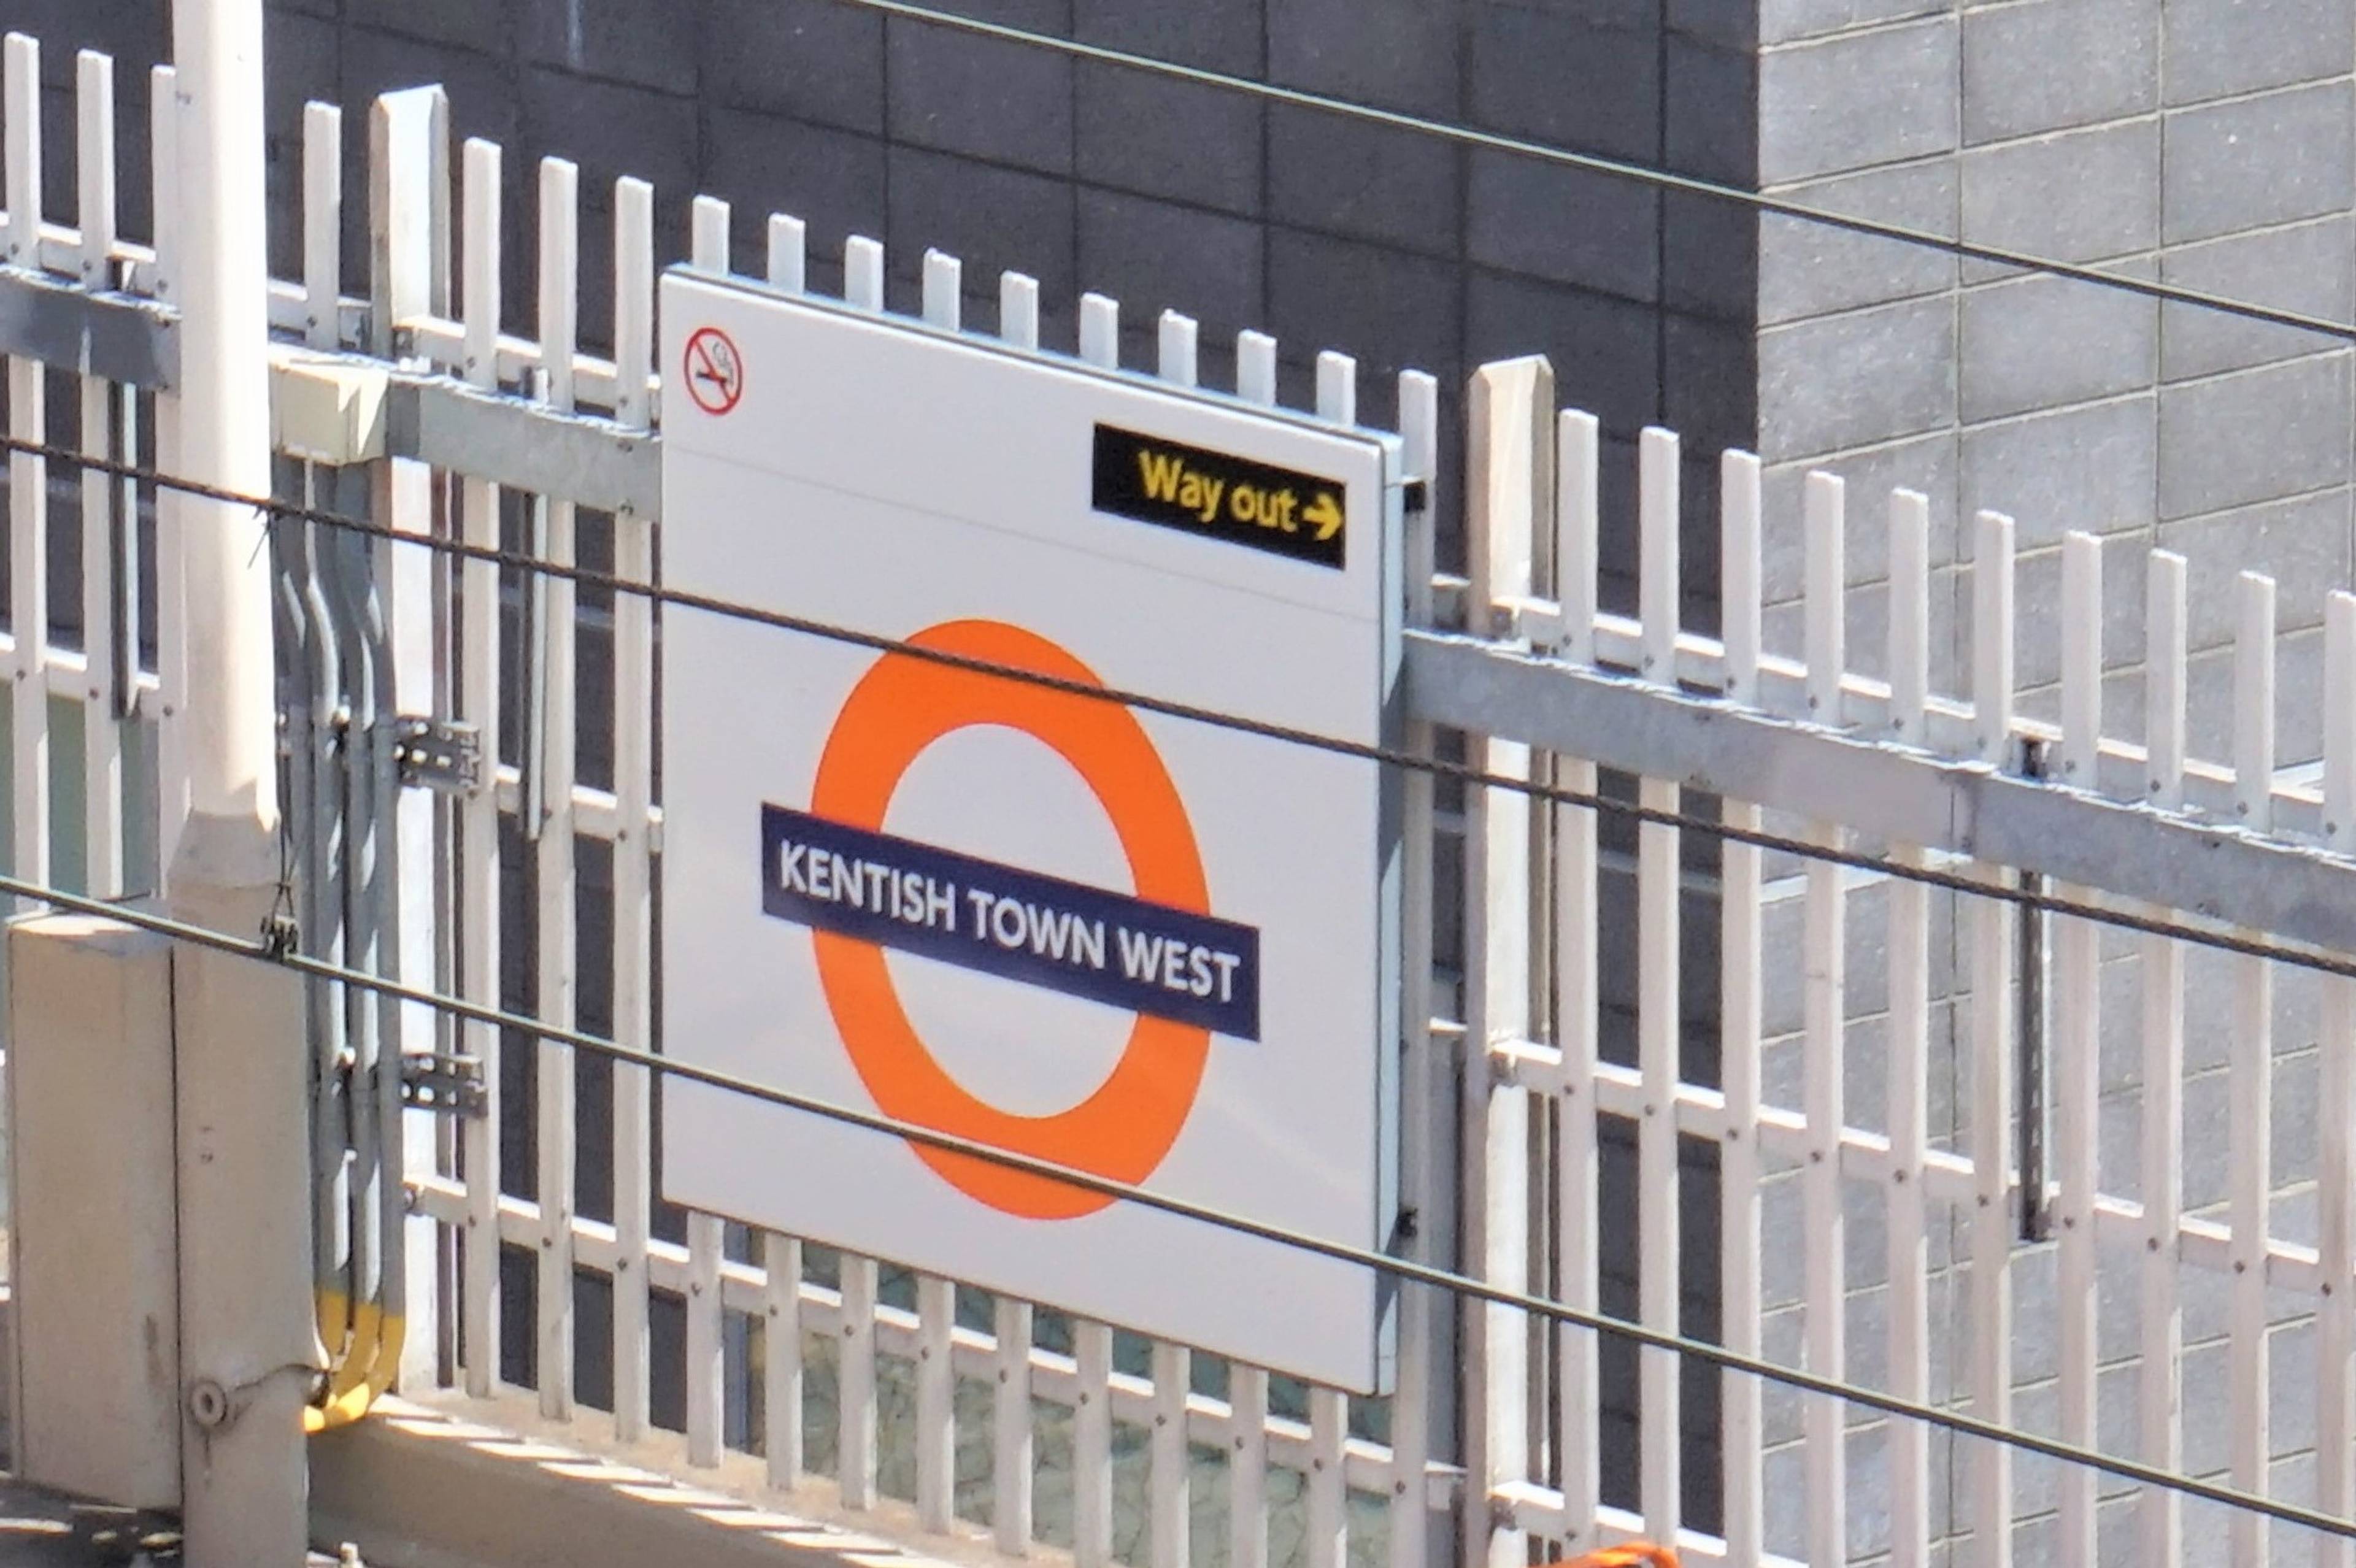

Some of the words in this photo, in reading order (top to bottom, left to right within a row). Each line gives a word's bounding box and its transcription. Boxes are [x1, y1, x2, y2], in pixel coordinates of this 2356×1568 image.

[1139, 450, 1223, 522] Way
[1230, 483, 1298, 532] out
[780, 839, 956, 932] KENTISH
[967, 888, 1104, 969] TOWN
[1118, 926, 1241, 1002] WEST
